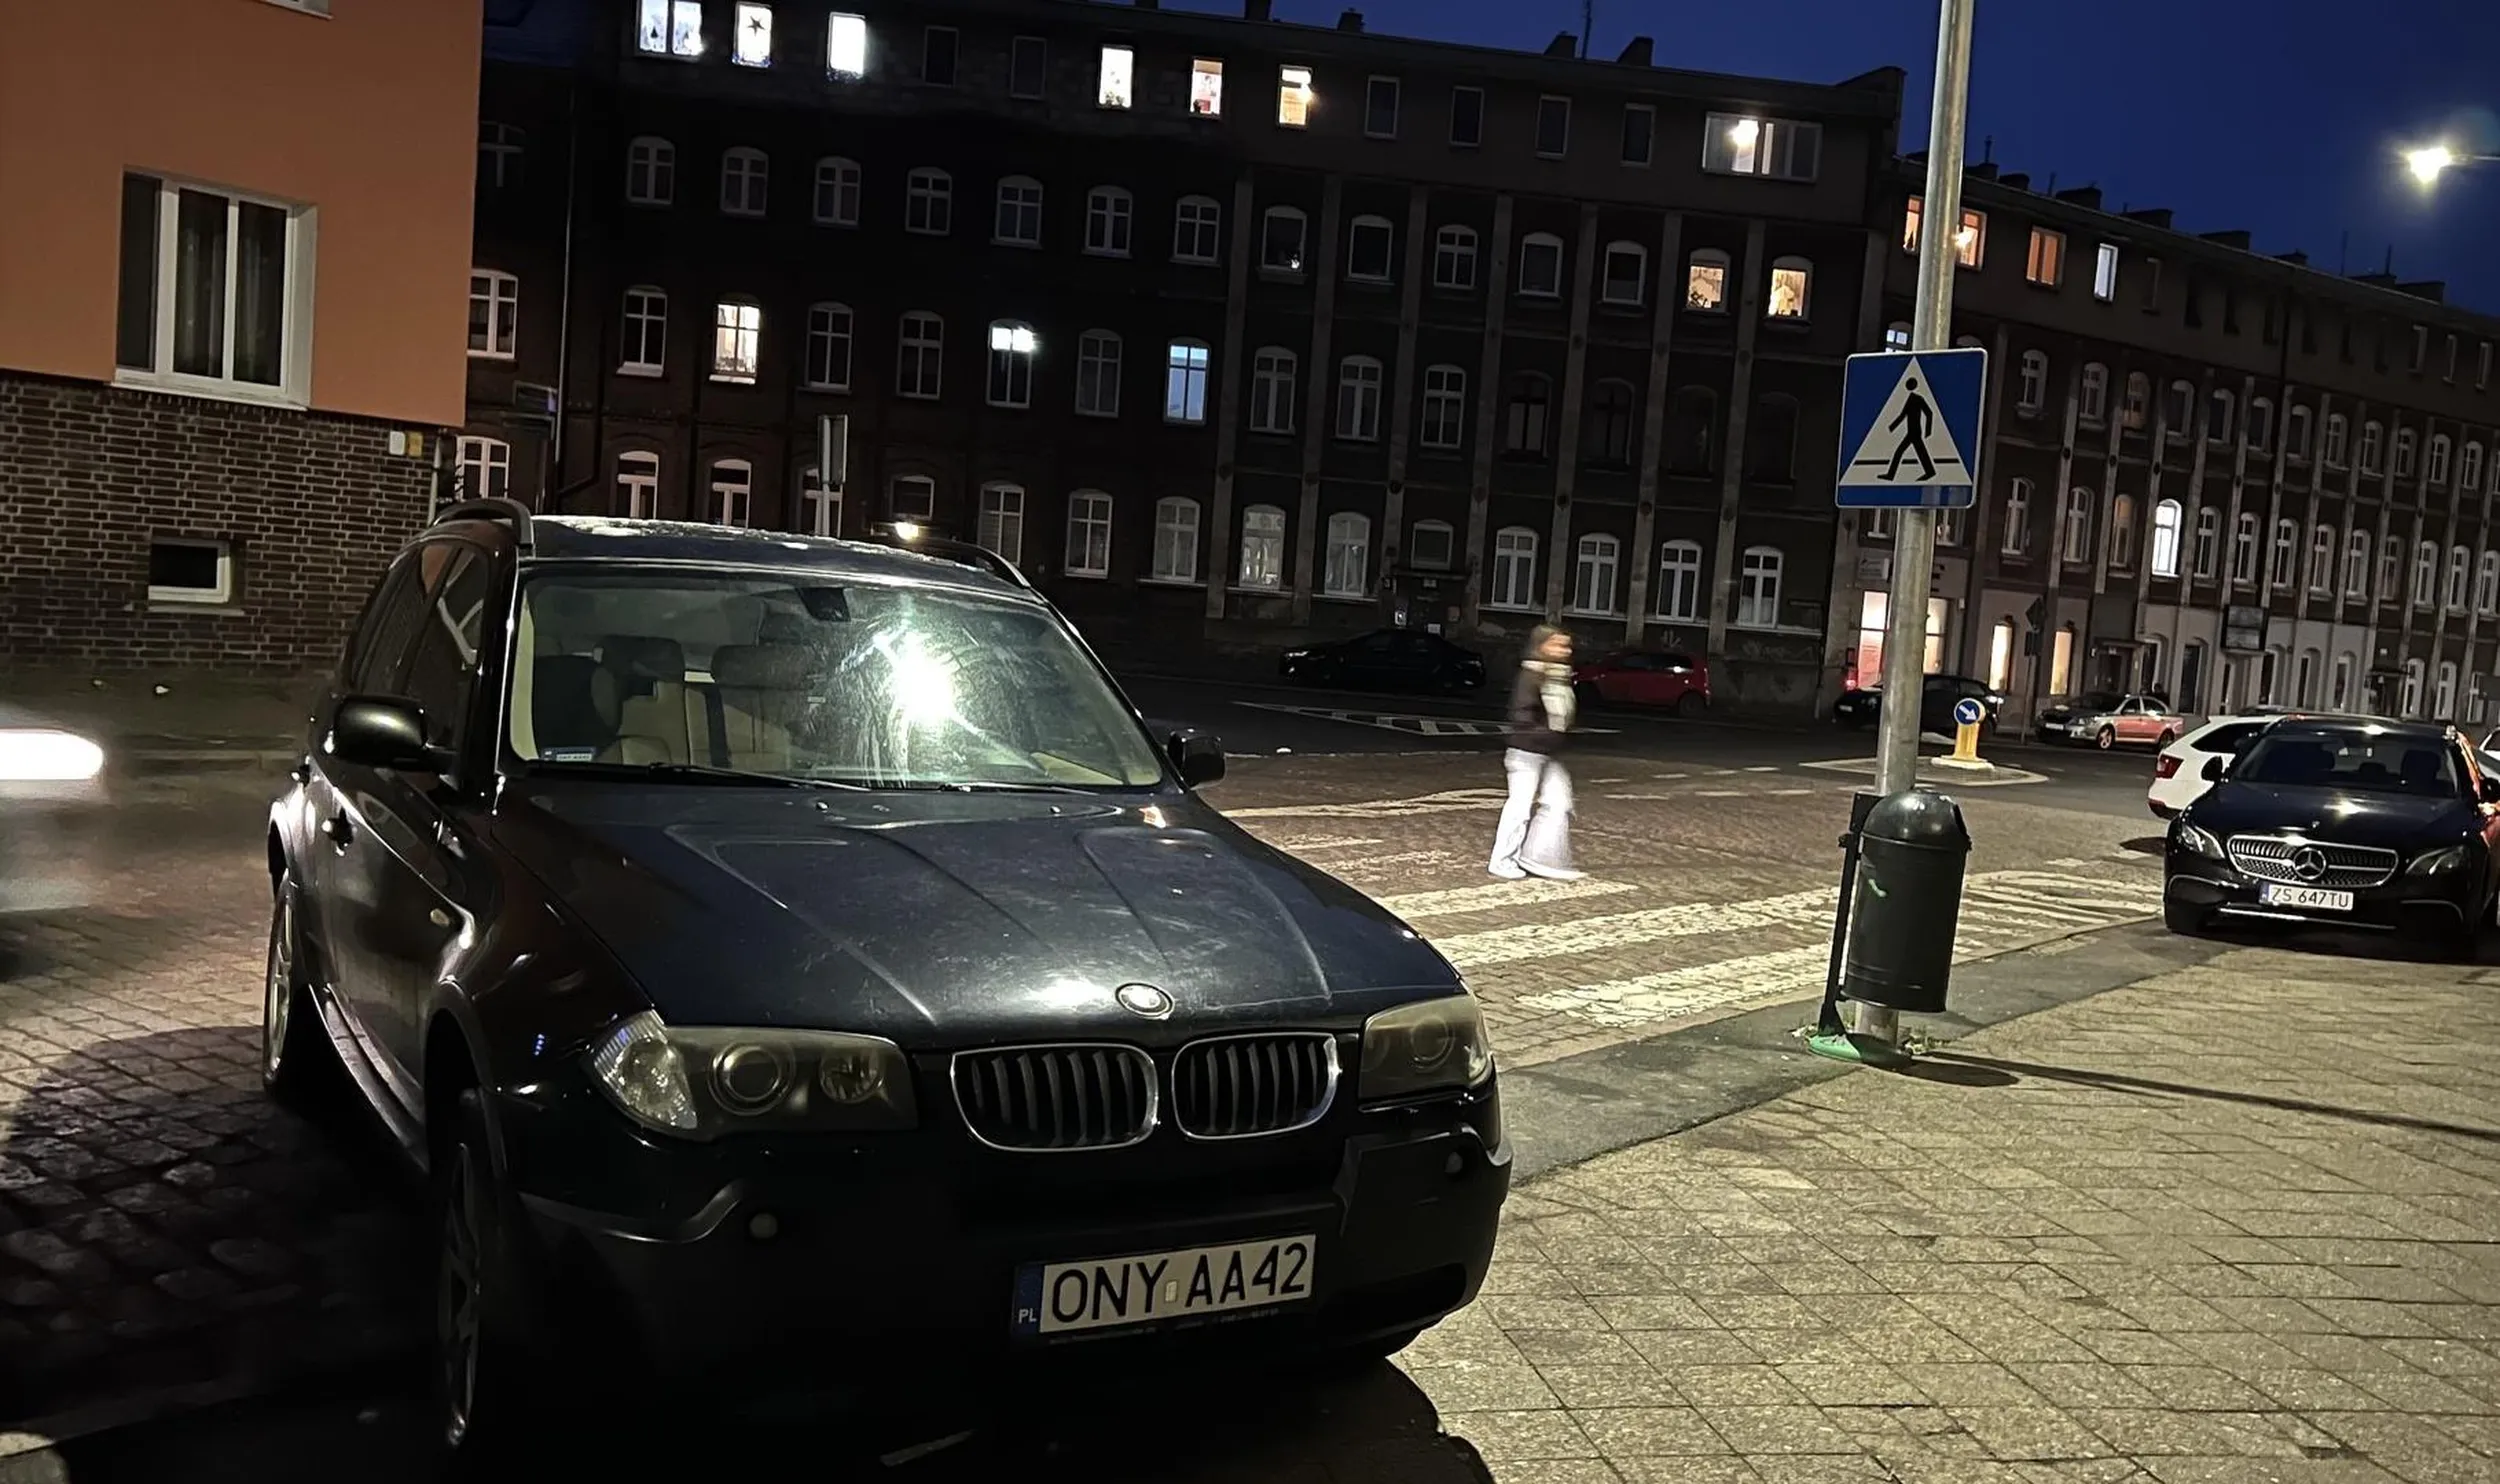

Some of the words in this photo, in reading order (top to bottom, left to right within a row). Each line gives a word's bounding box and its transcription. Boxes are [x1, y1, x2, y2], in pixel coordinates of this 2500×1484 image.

[2272, 887, 2292, 902] ZS
[2298, 890, 2349, 908] 647TU
[1052, 1259, 1169, 1323] ONY
[1185, 1243, 1308, 1308] AA42
[1018, 1307, 1037, 1325] PL
